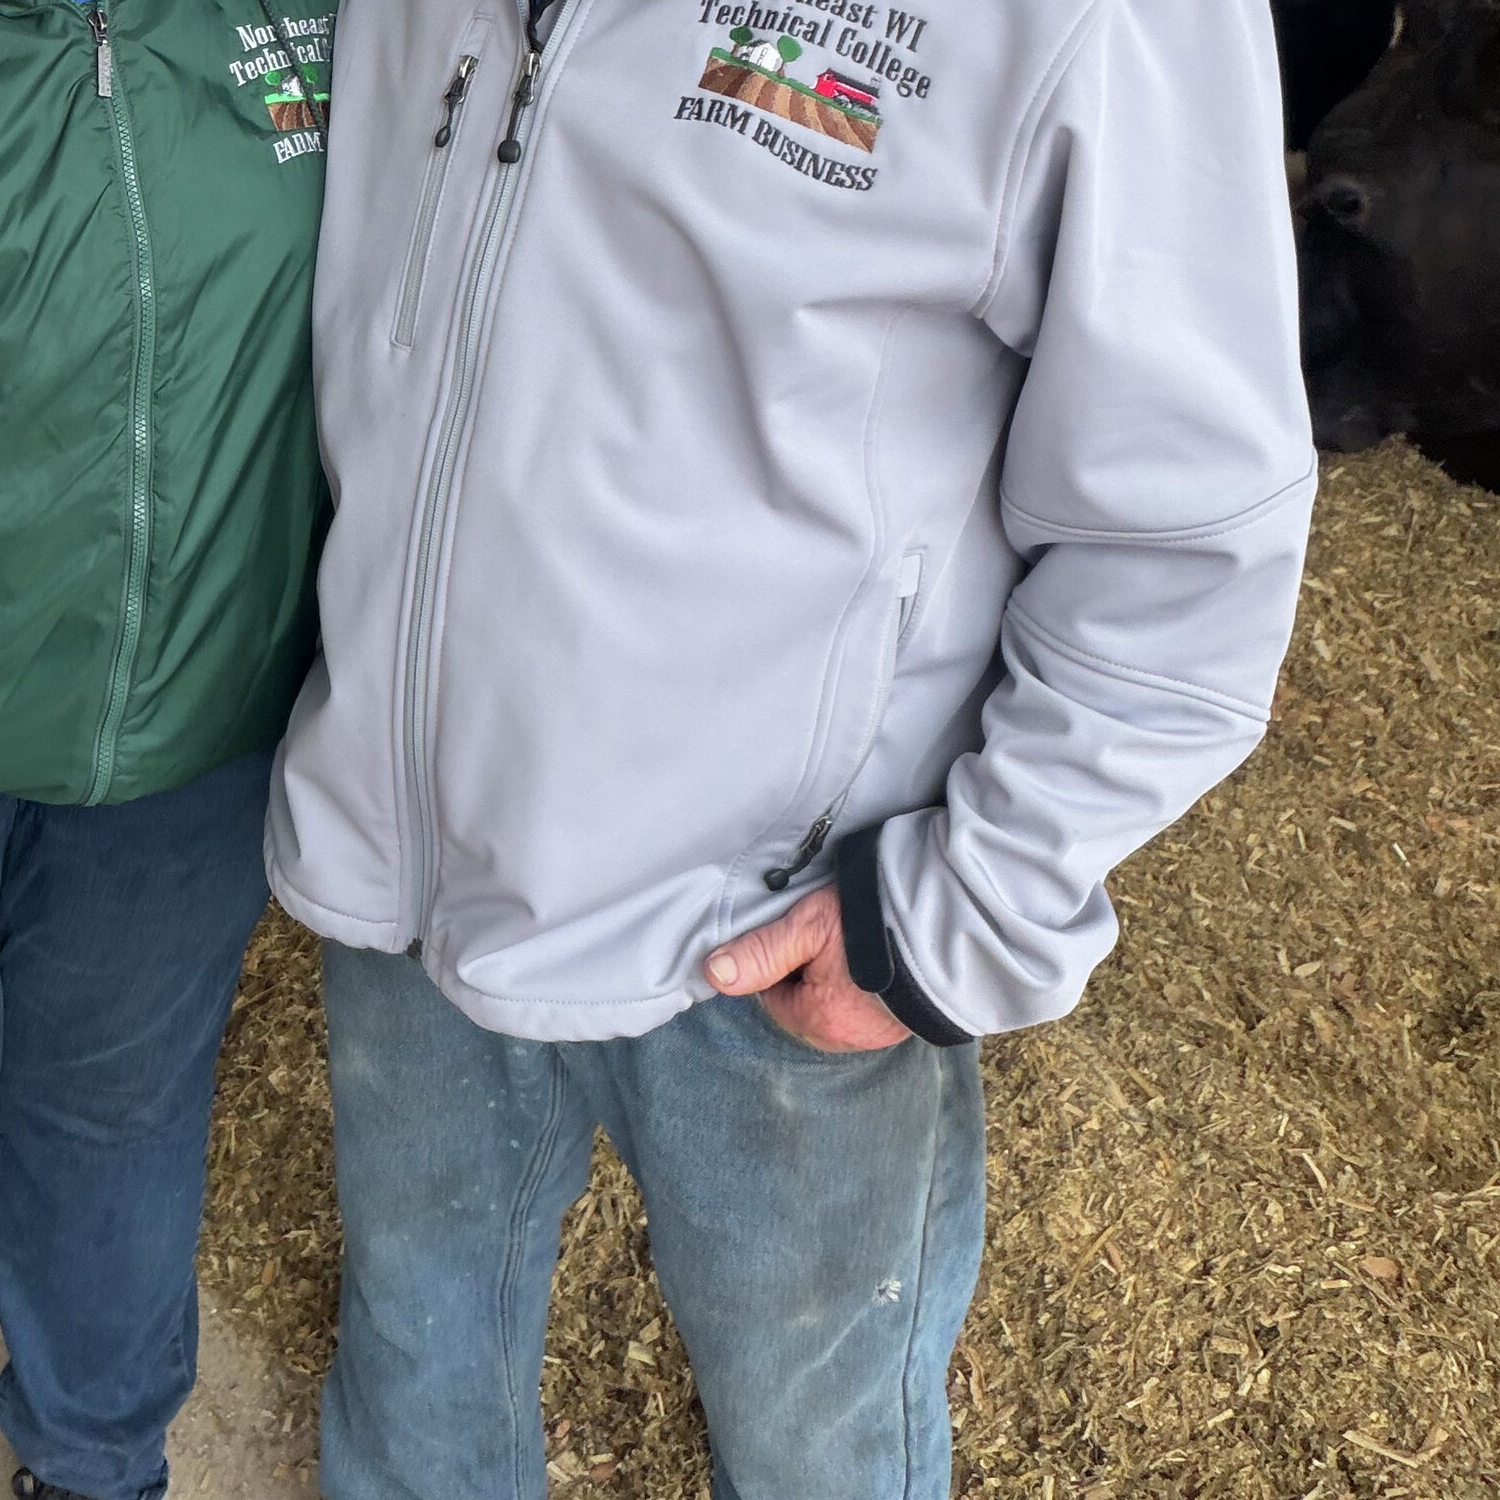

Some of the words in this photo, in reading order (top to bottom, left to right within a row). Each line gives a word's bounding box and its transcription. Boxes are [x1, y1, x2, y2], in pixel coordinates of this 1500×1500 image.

[235, 15, 330, 52] Norheast
[884, 8, 928, 53] WI
[835, 26, 932, 100] College
[673, 96, 754, 136] FARM
[752, 118, 878, 192] BUSINESS
